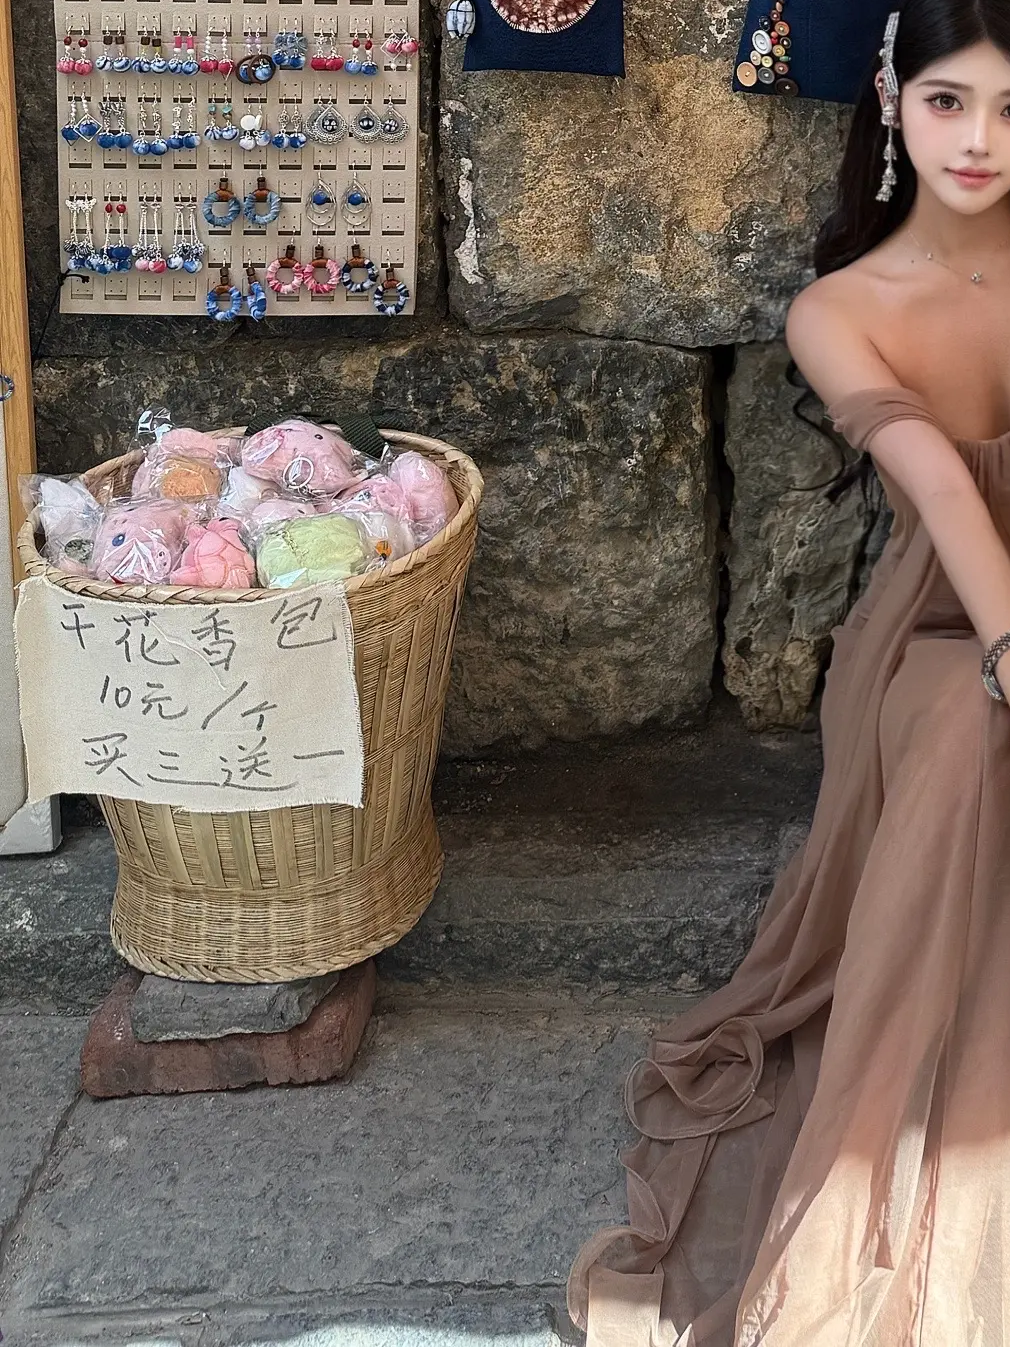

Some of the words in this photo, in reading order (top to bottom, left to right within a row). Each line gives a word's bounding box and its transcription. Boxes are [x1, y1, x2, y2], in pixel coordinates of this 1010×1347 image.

[60, 596, 338, 671] 干花香包
[99, 674, 278, 731] 10元/个
[82, 732, 345, 792] 买三送一
